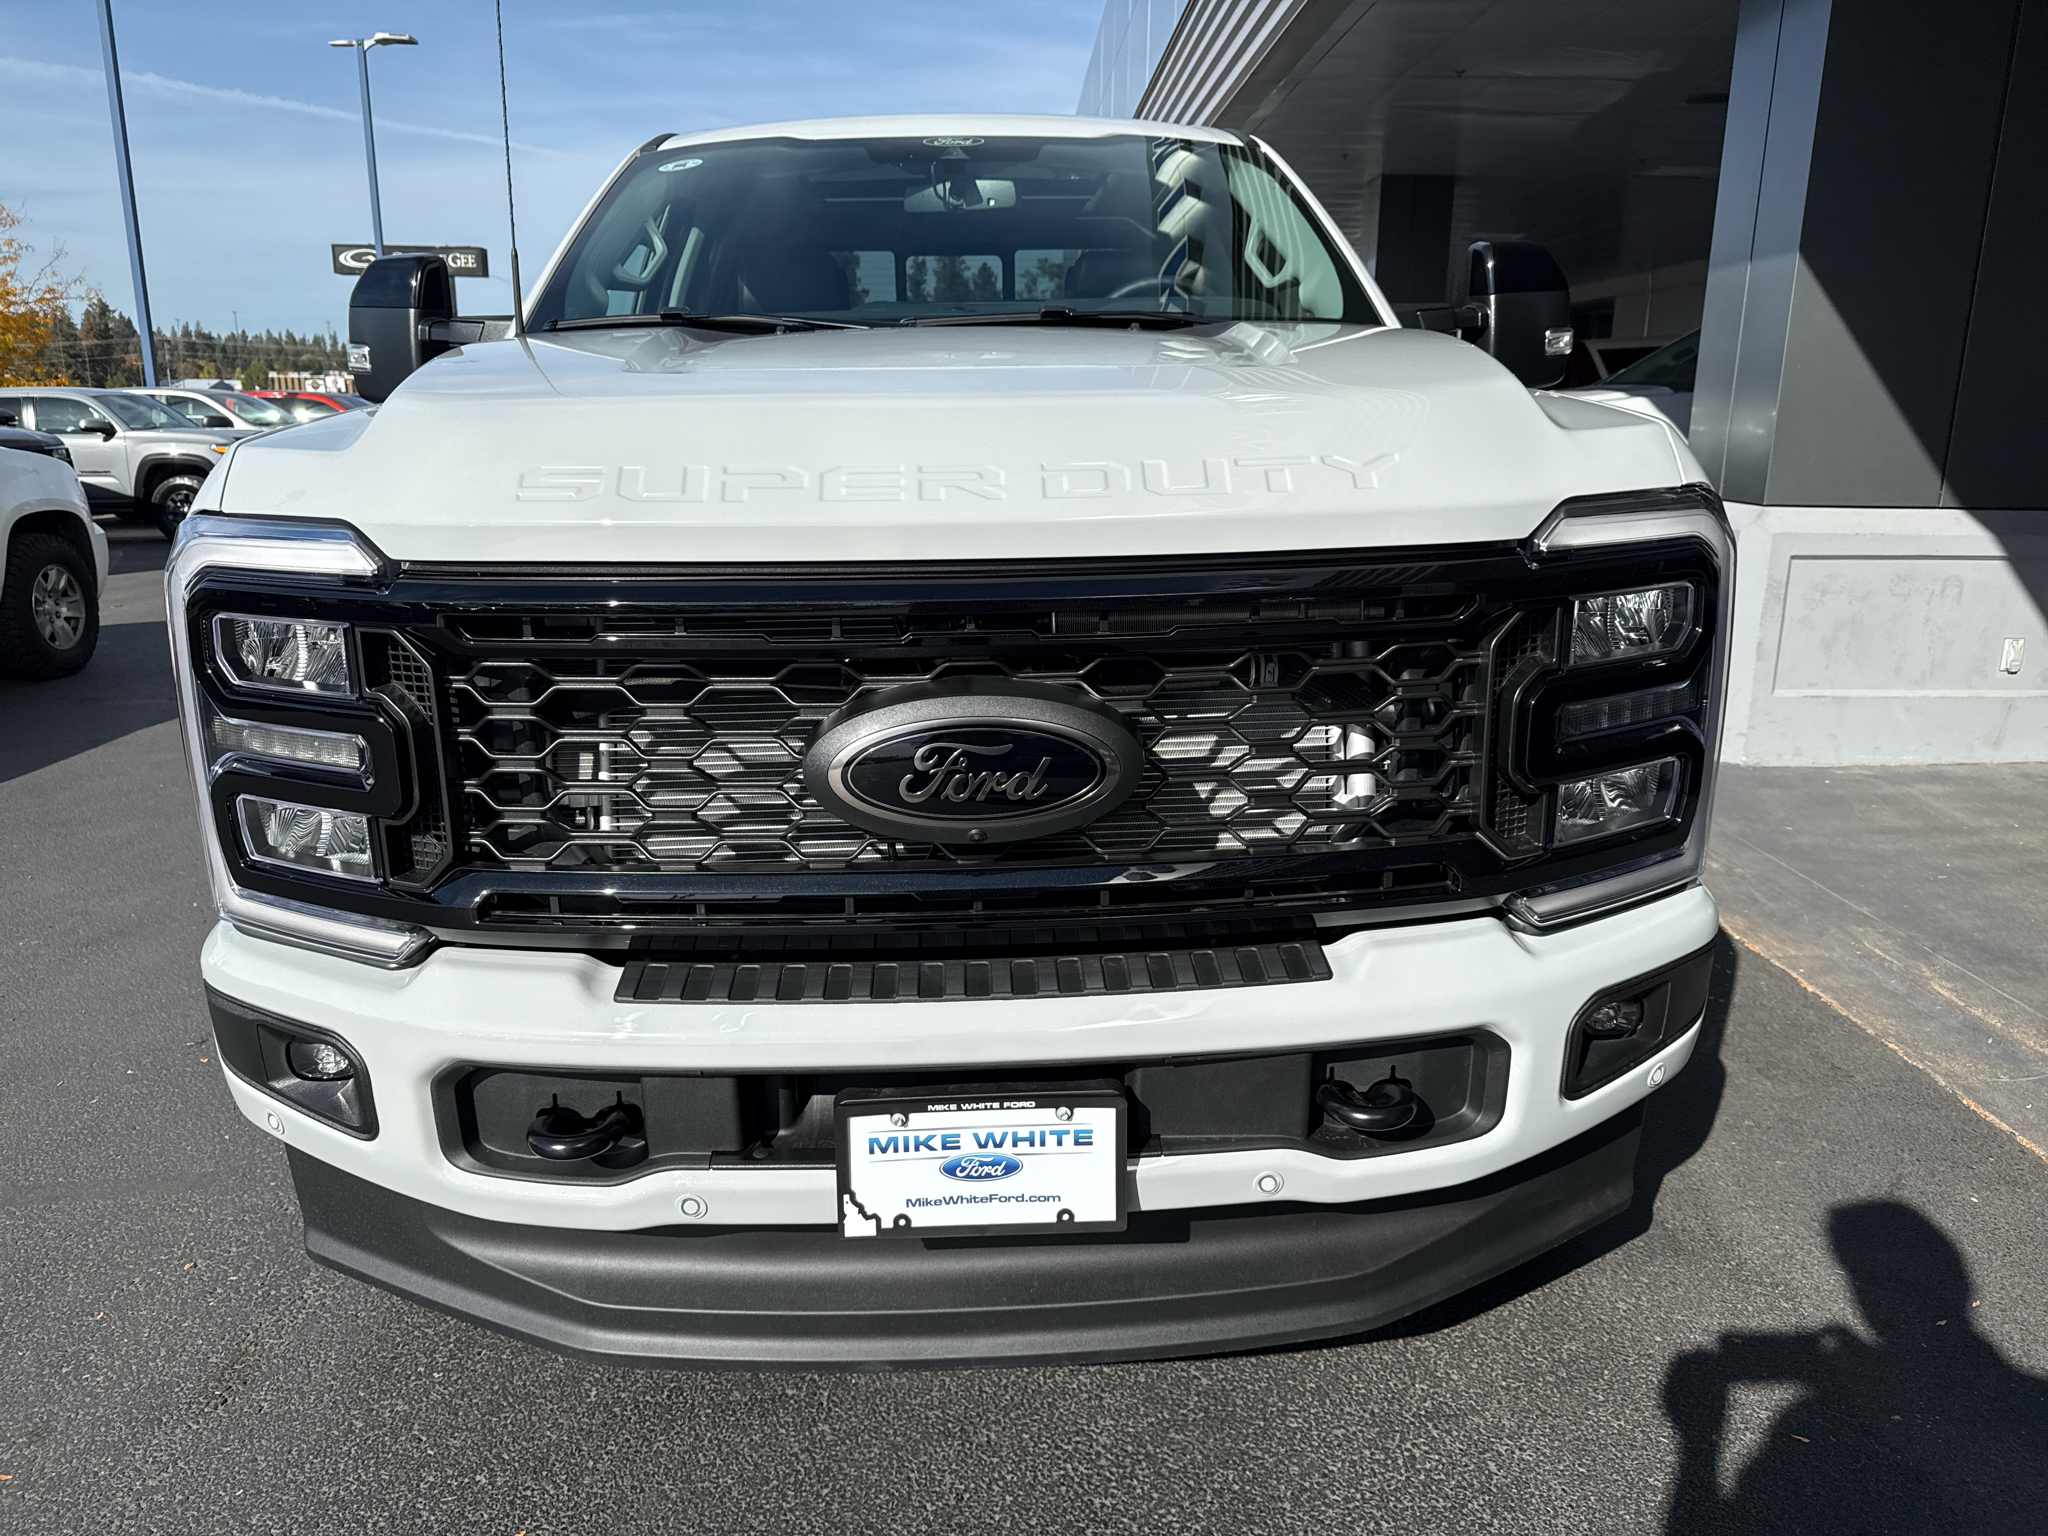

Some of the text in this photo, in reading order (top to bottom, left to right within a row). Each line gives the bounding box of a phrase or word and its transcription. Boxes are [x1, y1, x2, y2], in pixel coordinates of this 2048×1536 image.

[933, 137, 974, 146] Ford
[516, 452, 1401, 502] SUPER DUTY
[899, 742, 1052, 803] Ford
[927, 1100, 1036, 1112] MIKE WHITE FORD
[868, 1128, 1094, 1155] MIKE WHITE
[955, 1156, 1006, 1178] Ford
[905, 1192, 1062, 1208] MikeWhiteFord.com
